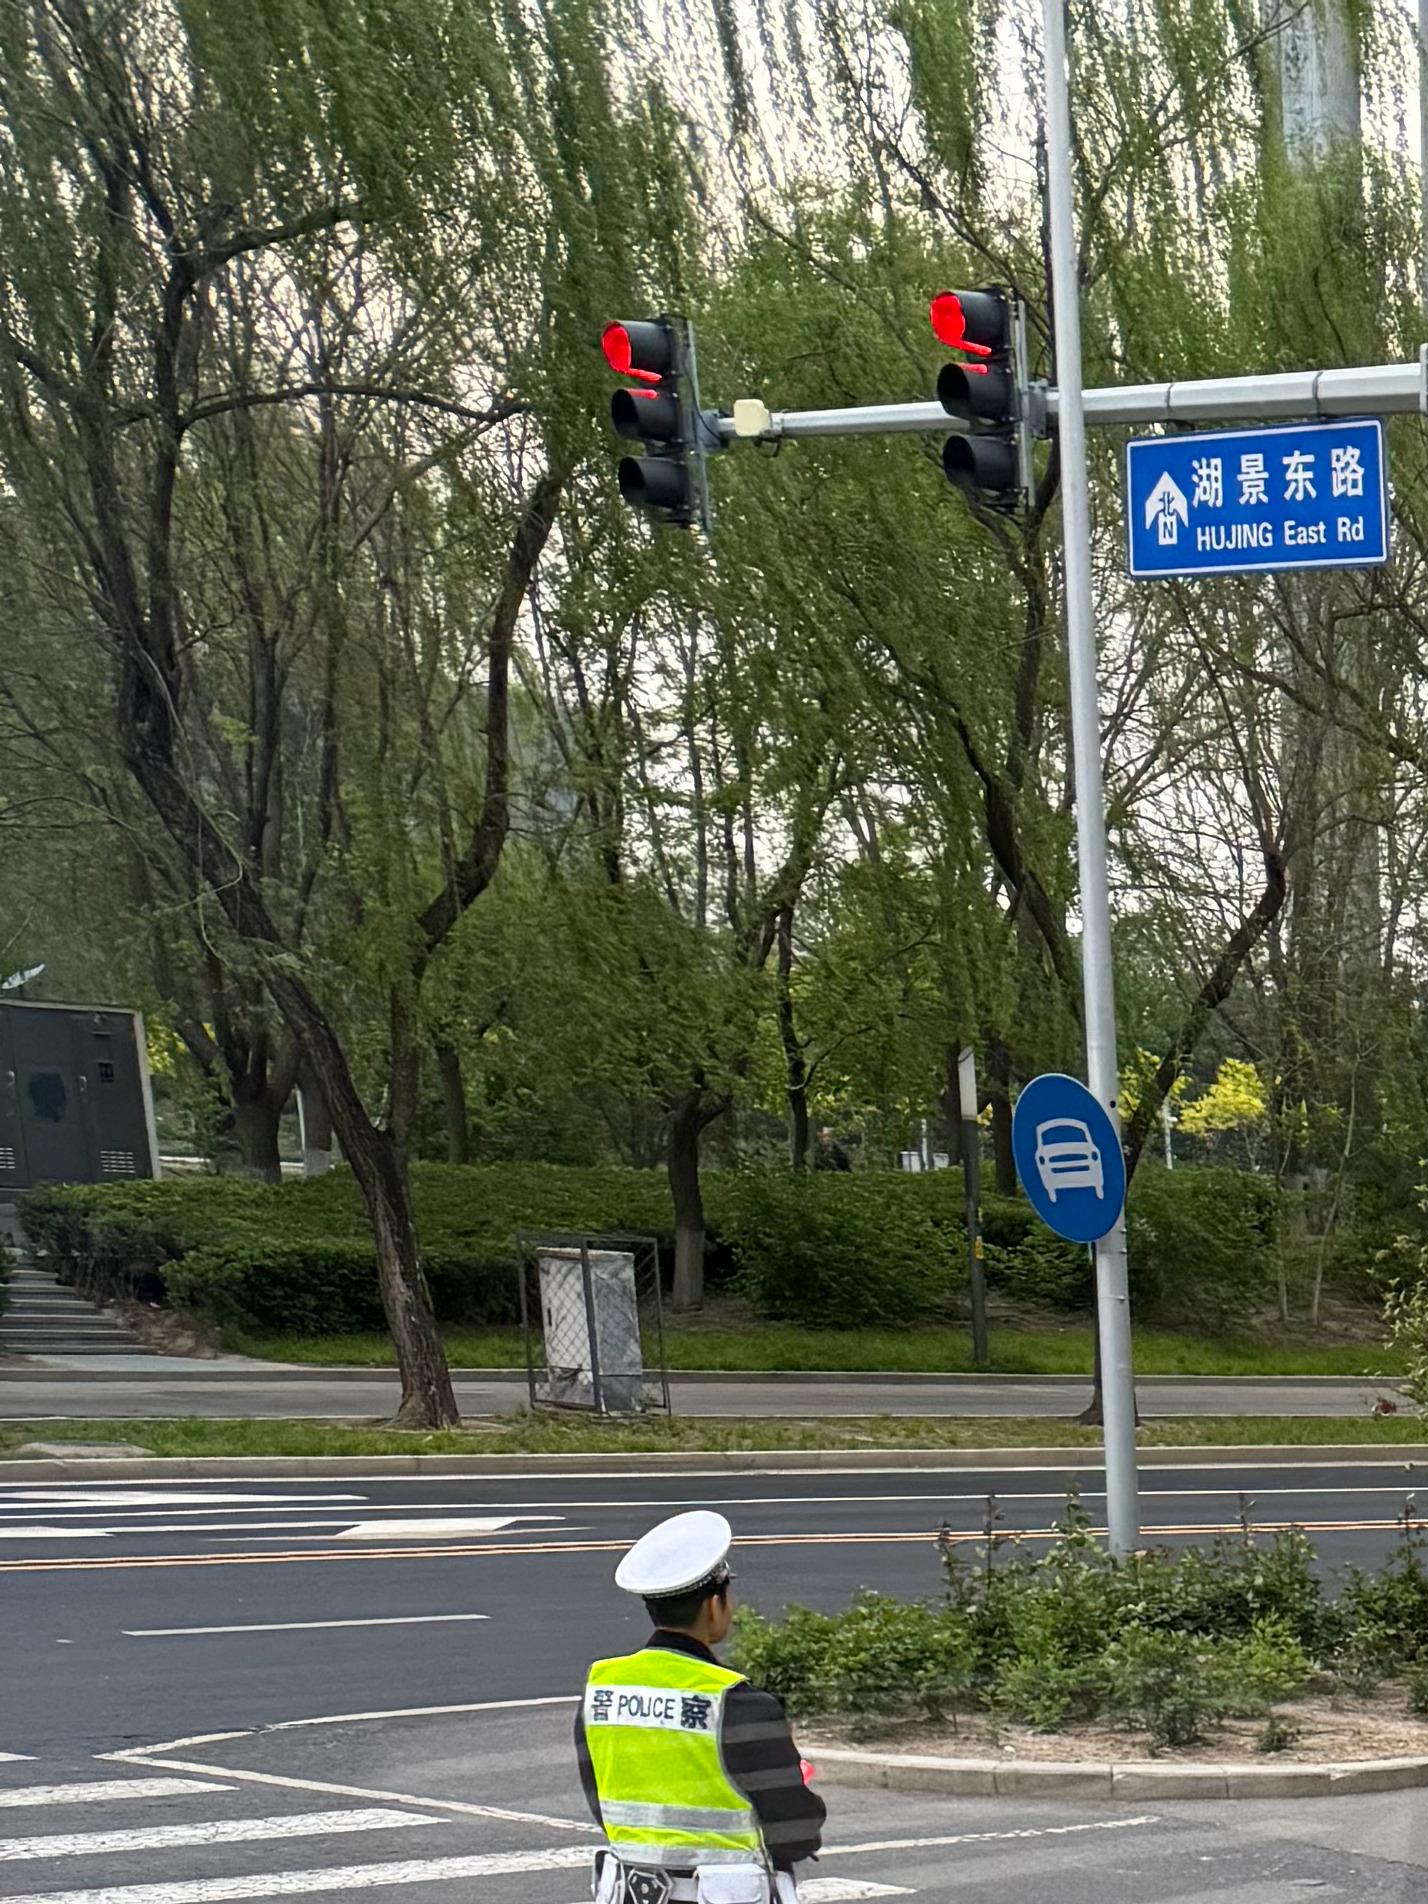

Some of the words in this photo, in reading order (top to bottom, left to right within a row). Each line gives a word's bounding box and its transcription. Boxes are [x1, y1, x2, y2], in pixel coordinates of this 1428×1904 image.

[1191, 445, 1365, 508] 湖景东路
[1158, 490, 1175, 517] 北
[1162, 520, 1174, 541] N
[1196, 521, 1273, 552] HUJING
[1283, 519, 1326, 546] East
[1336, 516, 1364, 543] Rd
[590, 1690, 613, 1722] 警
[617, 1693, 675, 1721] POLICE
[680, 1695, 712, 1730] 察
